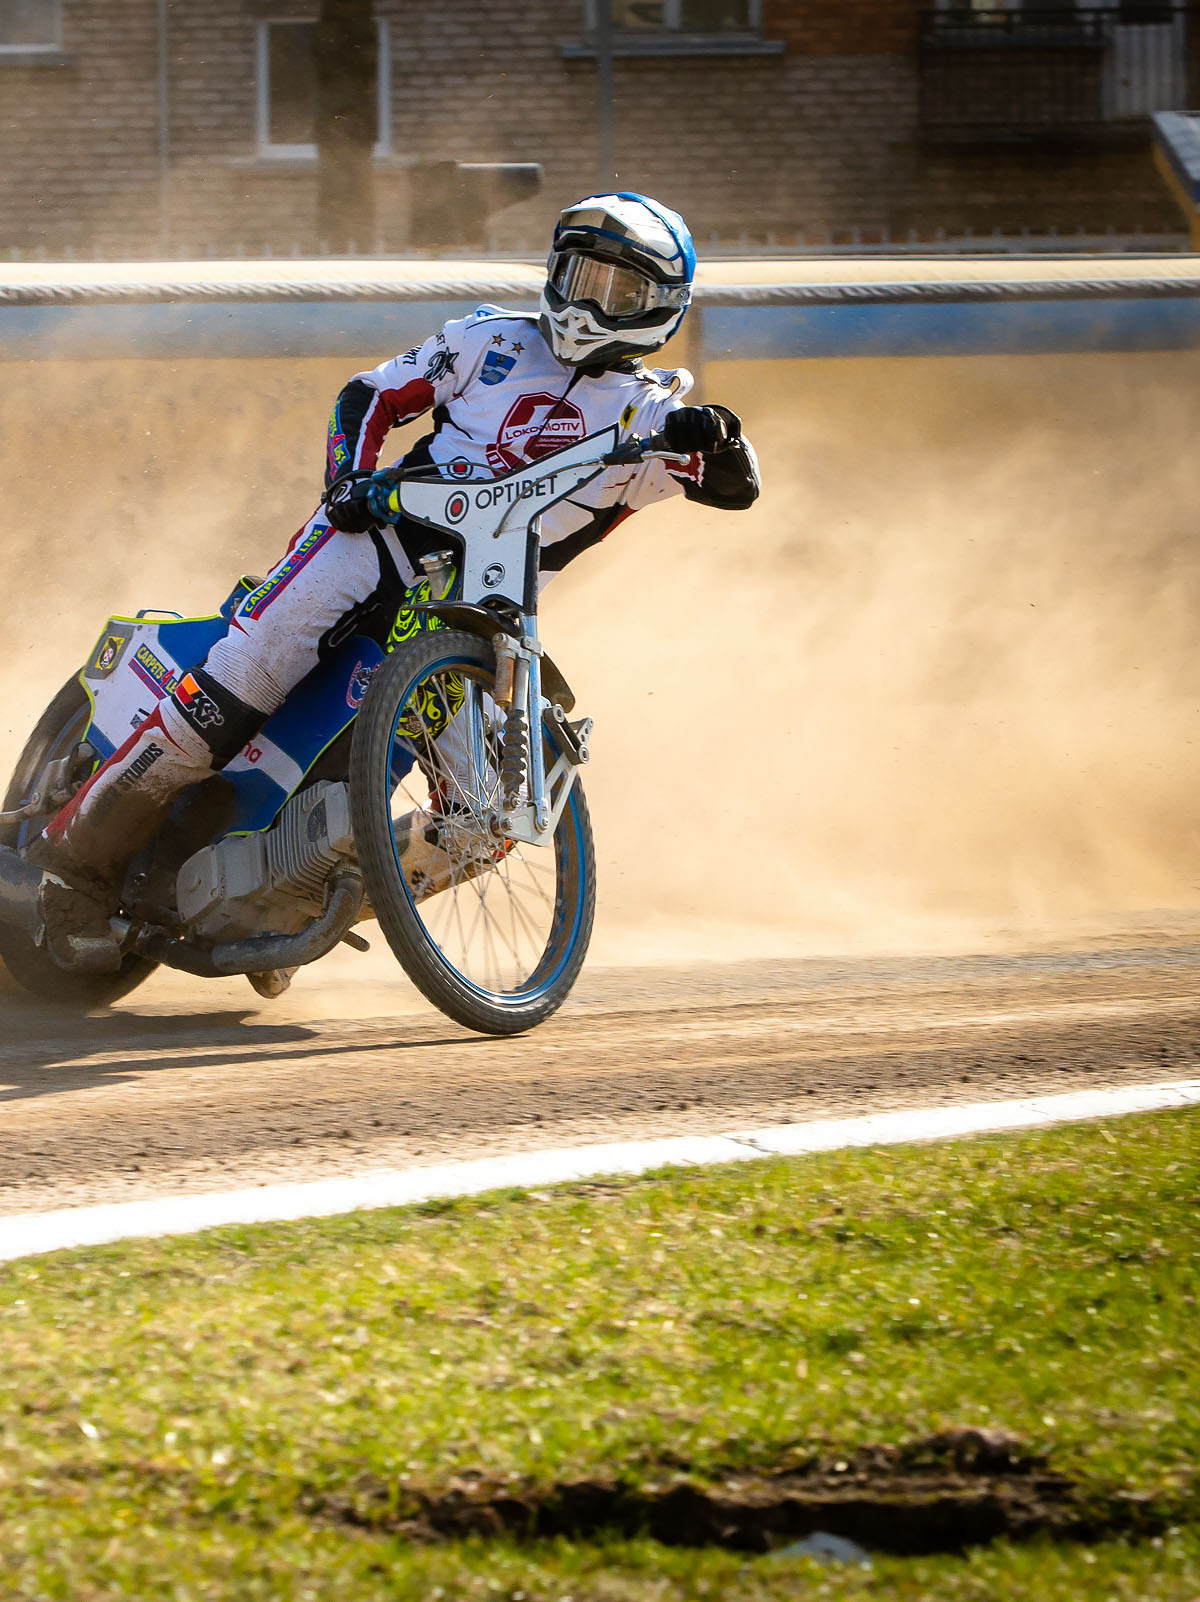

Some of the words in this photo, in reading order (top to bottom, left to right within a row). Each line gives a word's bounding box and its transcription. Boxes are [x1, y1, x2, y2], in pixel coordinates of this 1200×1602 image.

[505, 422, 580, 440] LOKOMOTIV
[475, 474, 558, 509] OPTIBET
[244, 566, 291, 612] CARPETS
[290, 553, 304, 564] 4
[299, 529, 323, 552] LESS
[137, 646, 166, 680] CARPETS
[160, 668, 175, 688] 4
